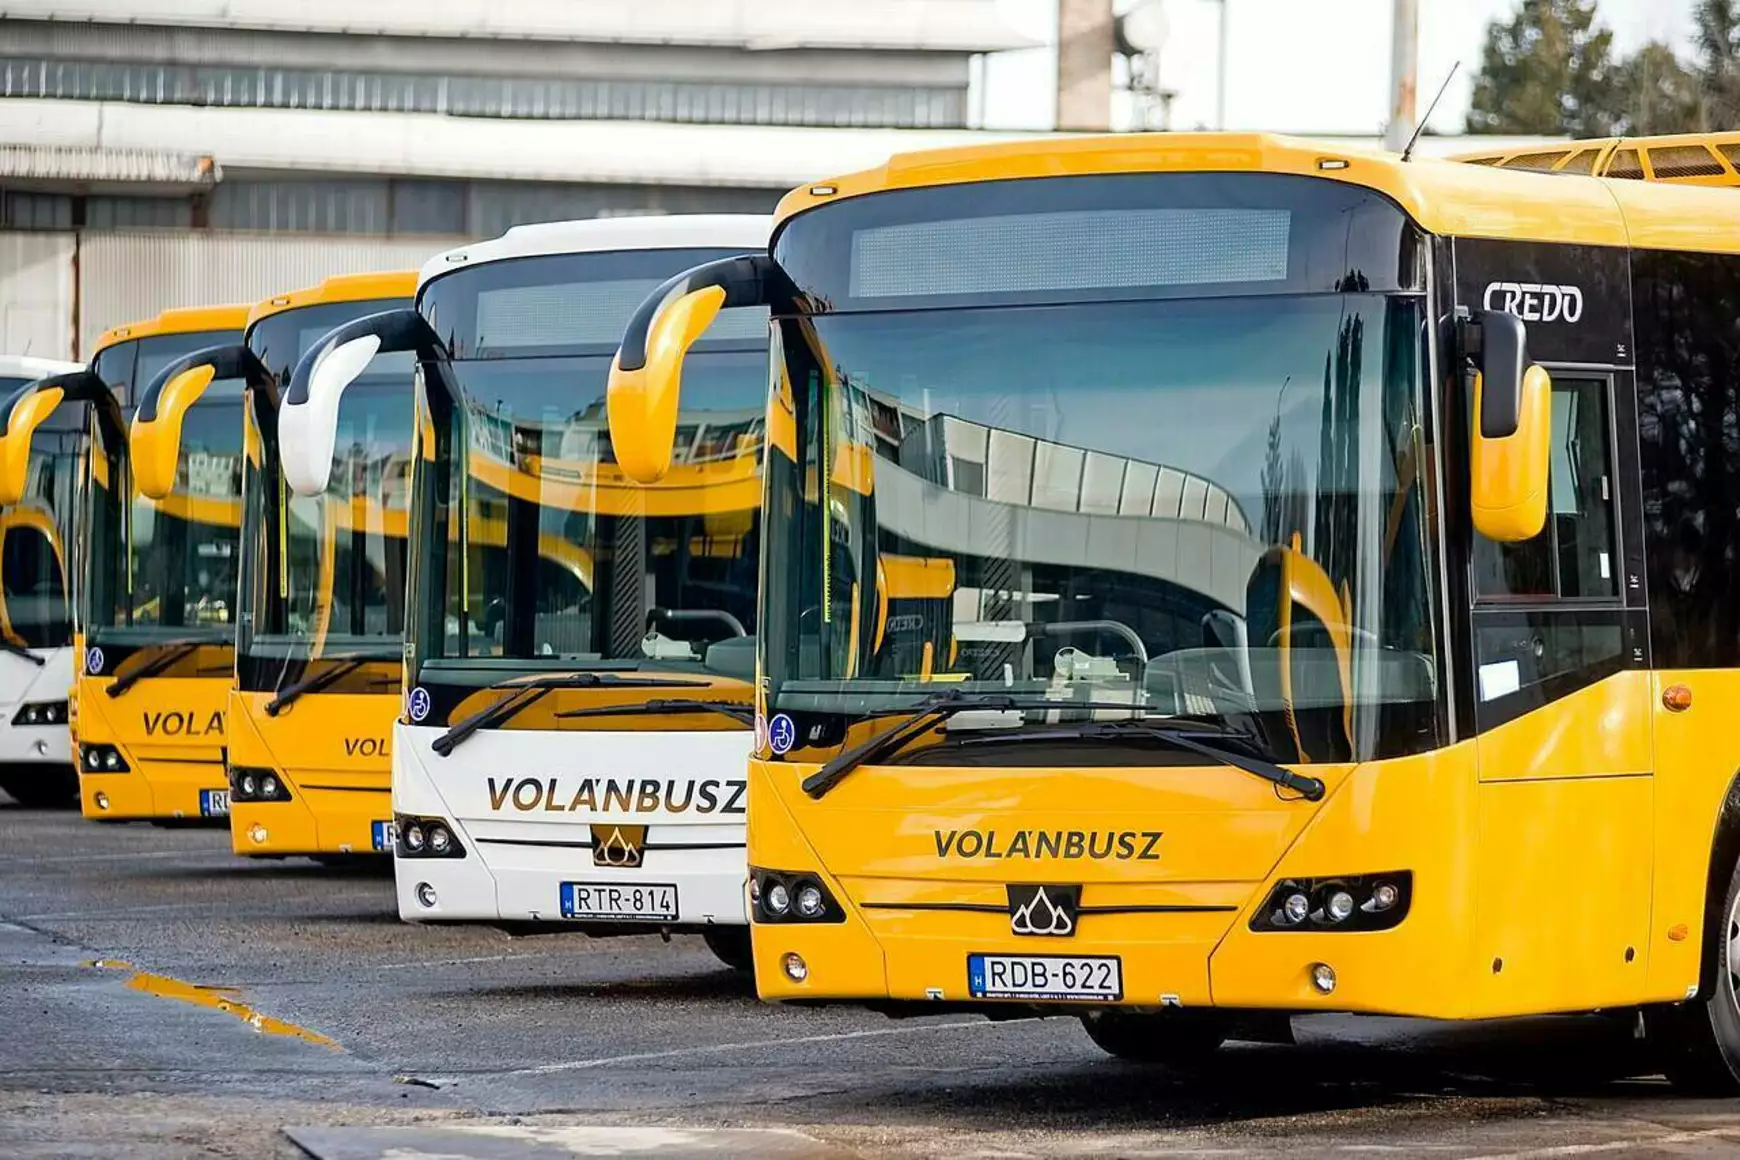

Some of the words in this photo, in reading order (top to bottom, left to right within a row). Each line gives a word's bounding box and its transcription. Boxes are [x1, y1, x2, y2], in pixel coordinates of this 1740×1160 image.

[1483, 282, 1583, 323] CREDO
[345, 738, 390, 757] VOL
[487, 777, 748, 814] VOLÁNBUSZ
[934, 830, 1164, 860] VOLÁNBUSZ
[578, 888, 671, 911] RTR-814
[991, 961, 1112, 990] RDB-622
